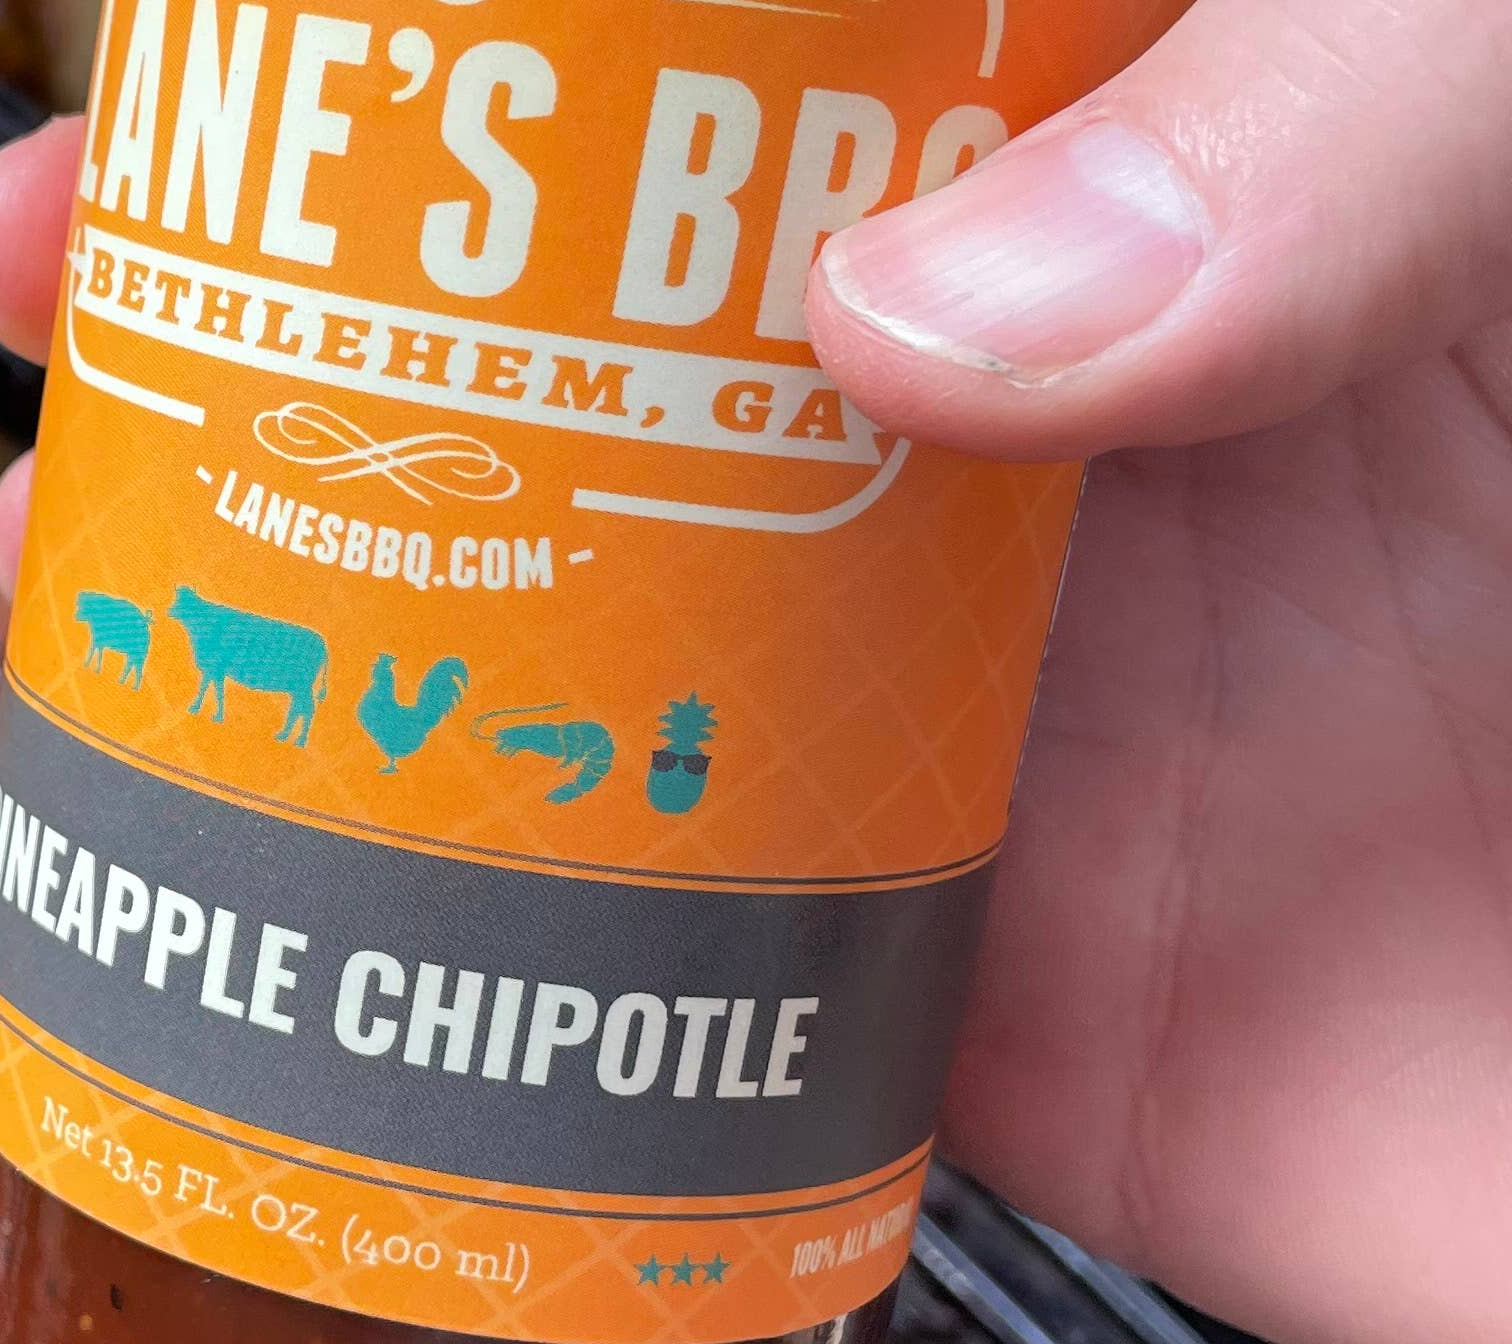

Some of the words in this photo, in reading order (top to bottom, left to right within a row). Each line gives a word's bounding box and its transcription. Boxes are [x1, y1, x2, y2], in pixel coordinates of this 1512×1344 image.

[87, 246, 665, 429] BETHLEHEM,
[711, 380, 849, 442] GA
[334, 949, 821, 1099] CHIPOTLE
[40, 1095, 93, 1157] Net
[100, 1139, 163, 1197] 13.5
[174, 1163, 235, 1219] FL.
[251, 1193, 325, 1247] OZ.
[341, 1213, 441, 1271] (400
[454, 1241, 530, 1294] ml)
[790, 1233, 838, 1279] 100%
